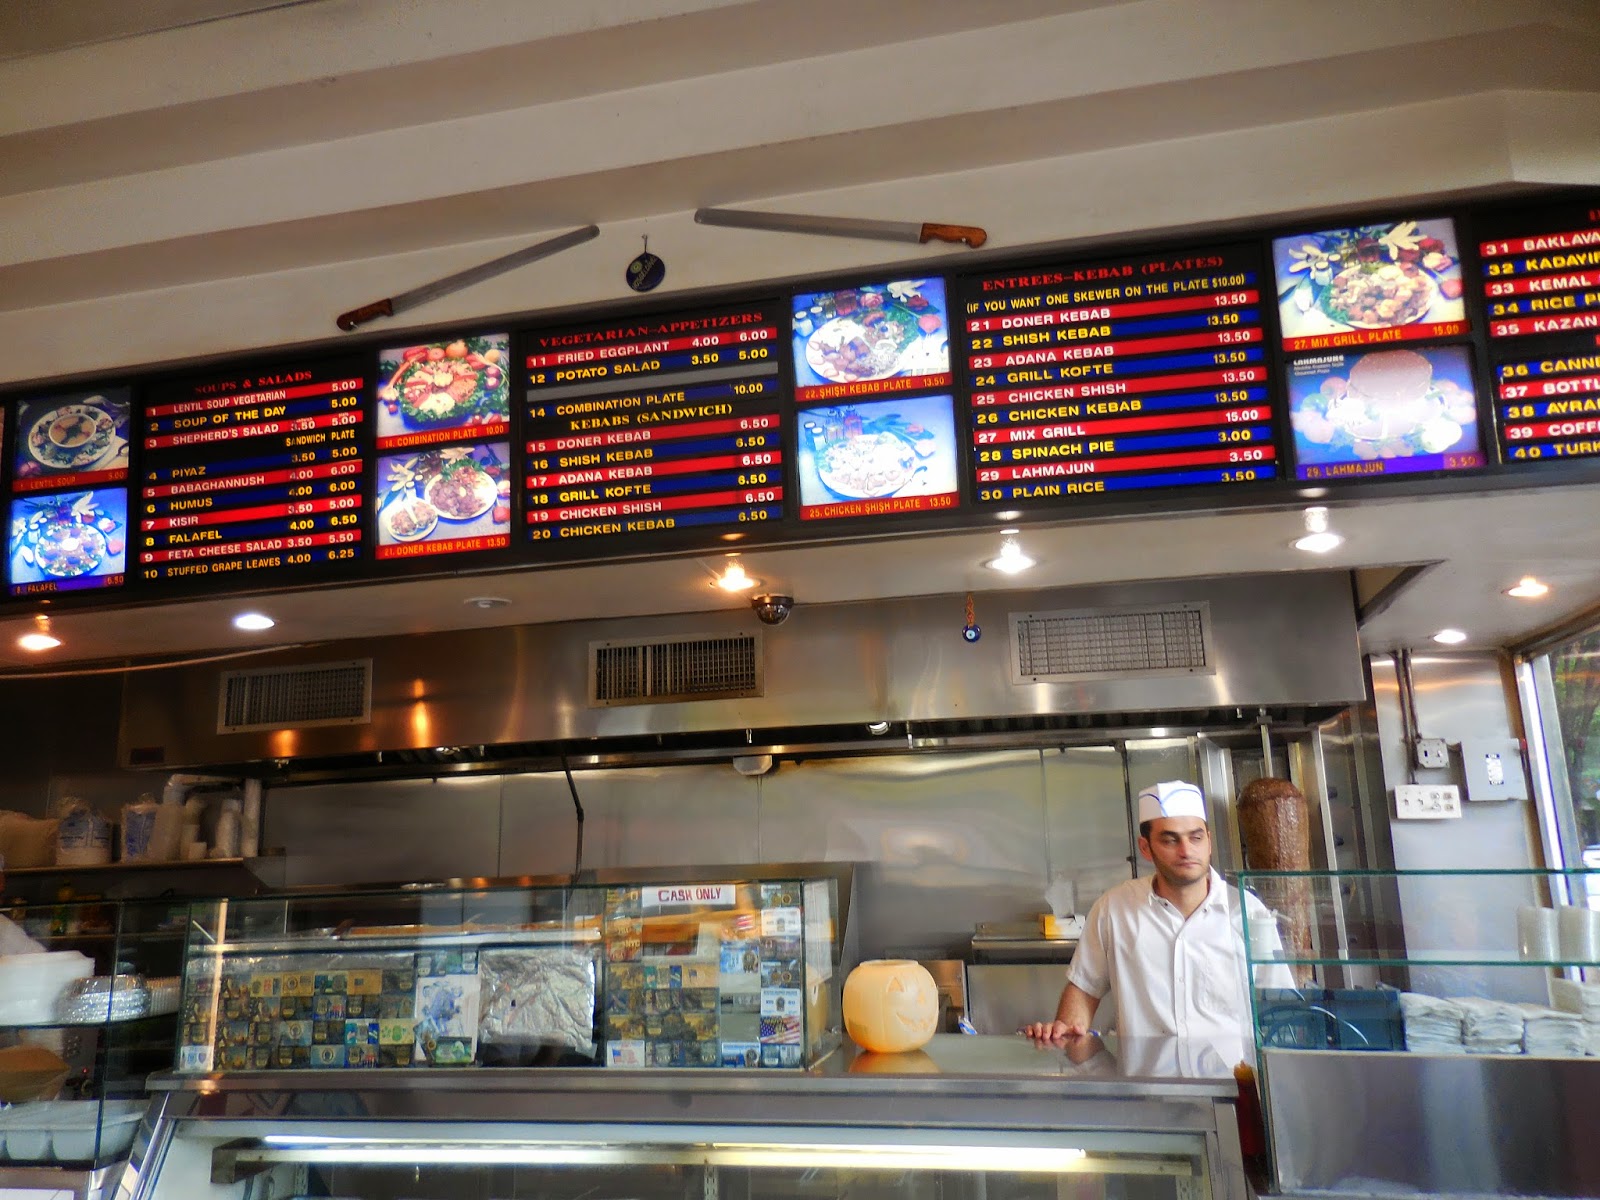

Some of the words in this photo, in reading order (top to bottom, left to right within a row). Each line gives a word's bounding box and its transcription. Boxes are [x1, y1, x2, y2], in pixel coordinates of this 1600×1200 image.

[1523, 232, 1600, 251] BAKLAVA
[1141, 256, 1223, 274] (PLATES)
[967, 302, 979, 314] (IF
[984, 301, 1006, 312] YOU
[1010, 297, 1040, 310] WANT
[1046, 294, 1069, 306] ONE
[1074, 288, 1120, 302] SKEWER
[1124, 286, 1141, 296] ON
[1146, 284, 1168, 294] THE
[1173, 279, 1208, 292] PLATE
[1212, 274, 1245, 289] $10.00)
[1492, 283, 1514, 295] 33
[1530, 275, 1591, 292] KEMAL
[971, 321, 990, 331] 21
[1002, 315, 1053, 329] DONER
[1060, 309, 1110, 322] KEBAB
[1214, 293, 1246, 306] 13.50
[1531, 296, 1576, 311] RICE
[972, 339, 992, 350] 22
[1003, 332, 1050, 347] SHISH
[1056, 326, 1111, 340] KEBAB
[1207, 314, 1238, 326] 13.50
[1311, 337, 1329, 349] MIX
[1334, 333, 1364, 345] GRILL
[1368, 330, 1402, 342] PLATE
[1497, 325, 1519, 335] 35
[1534, 315, 1597, 332] KAZAN
[531, 357, 546, 366] 11
[557, 351, 594, 363] FRIED
[600, 342, 669, 358] EGGPLANT
[692, 336, 719, 347] 4.00
[740, 330, 767, 342] 6.00
[974, 358, 992, 368] 23
[1006, 352, 1056, 366] ADANA
[1063, 346, 1114, 360] KEBAB
[1218, 331, 1250, 343] 13.50
[243, 379, 251, 388] &
[259, 371, 312, 386] SALADS
[556, 367, 607, 381] POTATO
[614, 360, 660, 374] SALAD
[691, 353, 719, 365] 3.50
[739, 349, 767, 360] 5.00
[976, 376, 995, 386] 24
[1007, 370, 1052, 383] GRILL
[1060, 364, 1113, 378] KOFTE
[1213, 352, 1246, 364] 13.50
[173, 403, 203, 413] LENTIL
[207, 398, 230, 409] SOUP
[234, 391, 286, 405] VEGETARIAN
[332, 381, 356, 392] 5.00
[556, 397, 640, 415] COMBINATION
[646, 392, 685, 404] PLATE
[734, 384, 763, 395] 10.00
[849, 382, 880, 394] KEBAB
[884, 380, 912, 390] PLATE
[976, 395, 995, 404] 25
[1008, 388, 1074, 403] CHICKEN
[1081, 383, 1126, 396] SHISH
[1222, 371, 1254, 382] 13.50
[1505, 386, 1528, 398] 37
[175, 417, 207, 428] SOUP
[213, 414, 229, 423] OF
[235, 410, 259, 421] THE
[264, 406, 286, 416] DAY
[331, 397, 357, 408] 5.00
[571, 415, 630, 430] KEBABS
[637, 403, 733, 424] (SANDWICH)
[977, 413, 998, 424] 26
[1008, 406, 1079, 422] CHICKEN
[1086, 400, 1142, 414] KEBAB
[1214, 390, 1247, 402] 13.50
[173, 429, 238, 445] SHEPHERD'S
[243, 424, 278, 436] SALAD
[332, 415, 356, 426] 5.00
[286, 433, 325, 447] SANDWICH
[331, 429, 355, 440] PLATE
[398, 431, 450, 447] COMBINATION
[453, 428, 477, 440] PLATE
[530, 443, 546, 452] 15
[557, 436, 601, 449] DONER
[607, 431, 651, 443] KEBAB
[740, 418, 768, 429] 6.50
[978, 433, 996, 443] 27
[1010, 429, 1035, 441] MIX
[1042, 425, 1086, 438] GRILL
[1226, 410, 1258, 422] 15.00
[1510, 427, 1533, 439] 39
[559, 454, 600, 468] SHISH
[606, 448, 653, 462] KEBAB
[736, 436, 765, 447] 6.50
[980, 451, 1001, 462] 28
[1012, 443, 1082, 460] SPINACH
[1089, 441, 1114, 452] PIE
[1218, 430, 1250, 442] 3.00
[172, 466, 206, 478] PIYAZ
[332, 447, 357, 458] 5.00
[532, 477, 547, 487] 17
[559, 472, 603, 485] ADANA
[608, 466, 652, 479] KEBAB
[743, 454, 771, 465] 6.50
[981, 470, 1000, 480] 29
[1012, 462, 1094, 479] LAHMAJUN
[1230, 450, 1262, 462] 3.50
[1326, 462, 1384, 476] LAHMAJUN
[171, 476, 265, 494] BABAGHANNUSH
[331, 465, 355, 475] 6.00
[560, 489, 599, 503] GRILL
[605, 484, 652, 498] KOFTE
[738, 474, 766, 485] 6.50
[981, 490, 1002, 500] 30
[1012, 484, 1060, 498] PLAIN
[1067, 482, 1104, 494] RICE
[1221, 470, 1254, 482] 3.50
[170, 498, 213, 511] HUMUS
[330, 481, 355, 492] 6.00
[560, 506, 617, 520] CHICKEN
[623, 502, 662, 514] SHISH
[745, 491, 774, 503] 6.50
[824, 503, 861, 515] CHICKEN
[893, 499, 921, 509] PLATE
[929, 497, 951, 507] 13.50
[169, 516, 199, 527] KISIR
[329, 498, 354, 509] 5.00
[560, 523, 622, 538] CHICKEN
[627, 518, 675, 532] KEBAB
[738, 510, 767, 522] 6.50
[169, 530, 222, 544] FALAFEL
[290, 520, 314, 531] 4.00
[331, 515, 357, 526] 6.50
[168, 549, 194, 559] FETA
[200, 545, 241, 557] CHEESE
[246, 540, 282, 552] SALAD
[287, 537, 312, 548] 3.50
[329, 532, 353, 543] 5.50
[397, 544, 424, 555] DONER
[426, 541, 453, 552] KEBAB
[456, 540, 480, 549] PLATE
[168, 565, 208, 577] STUFFED
[212, 561, 243, 572] GRAPE
[247, 557, 280, 569] LEAVES
[287, 554, 311, 564] 4.00
[328, 549, 354, 560] 6.25
[658, 889, 693, 903] CASH
[696, 888, 722, 900] ONLY
